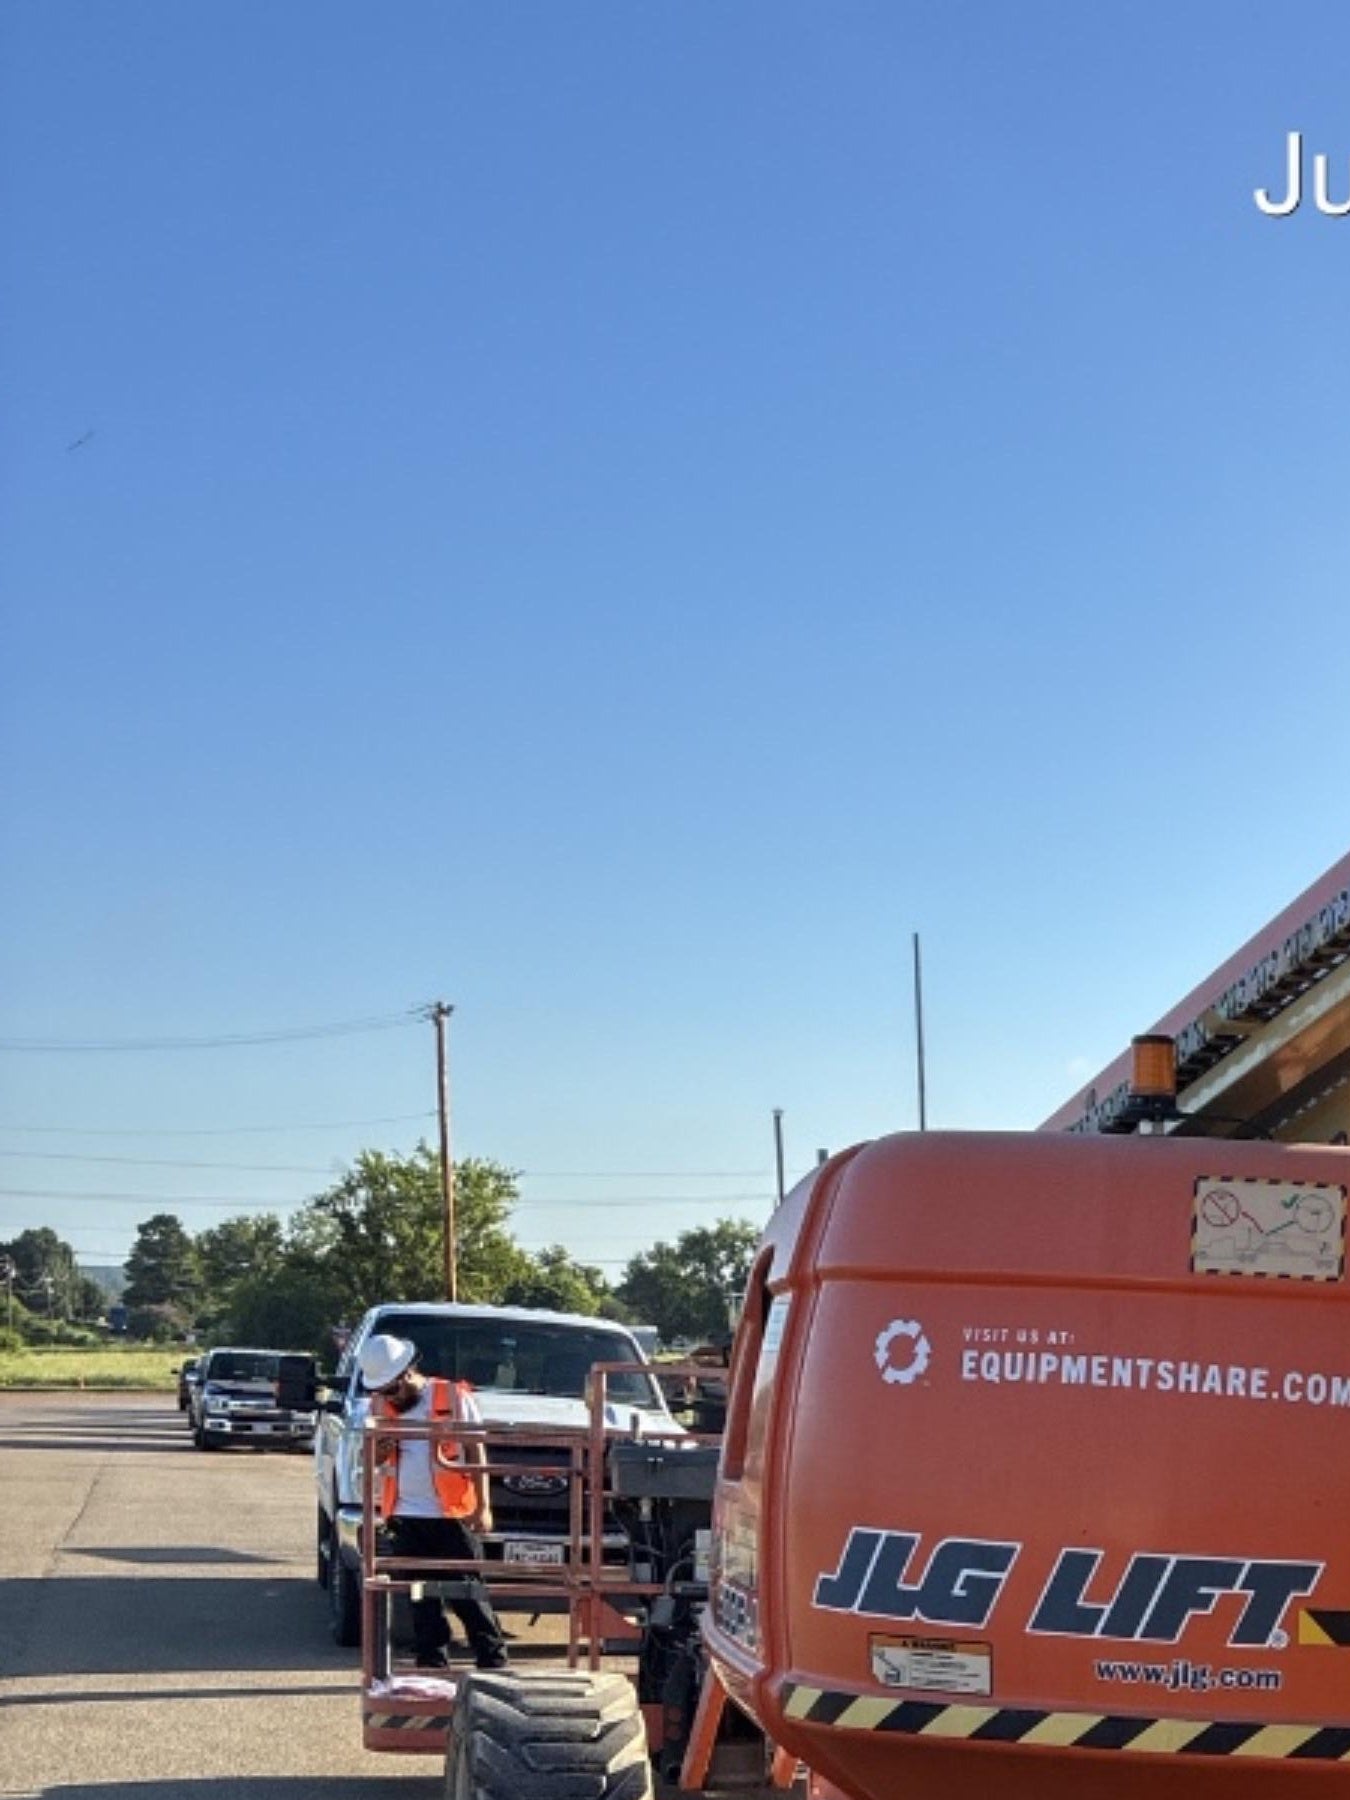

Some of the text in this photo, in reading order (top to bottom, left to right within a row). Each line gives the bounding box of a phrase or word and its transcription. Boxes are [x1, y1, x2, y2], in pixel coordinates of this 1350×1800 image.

[962, 1327, 1010, 1343] VISIT
[1016, 1329, 1040, 1344] US
[812, 1526, 1022, 1629] JLG
[1094, 1660, 1283, 1692] www.jlg.com
